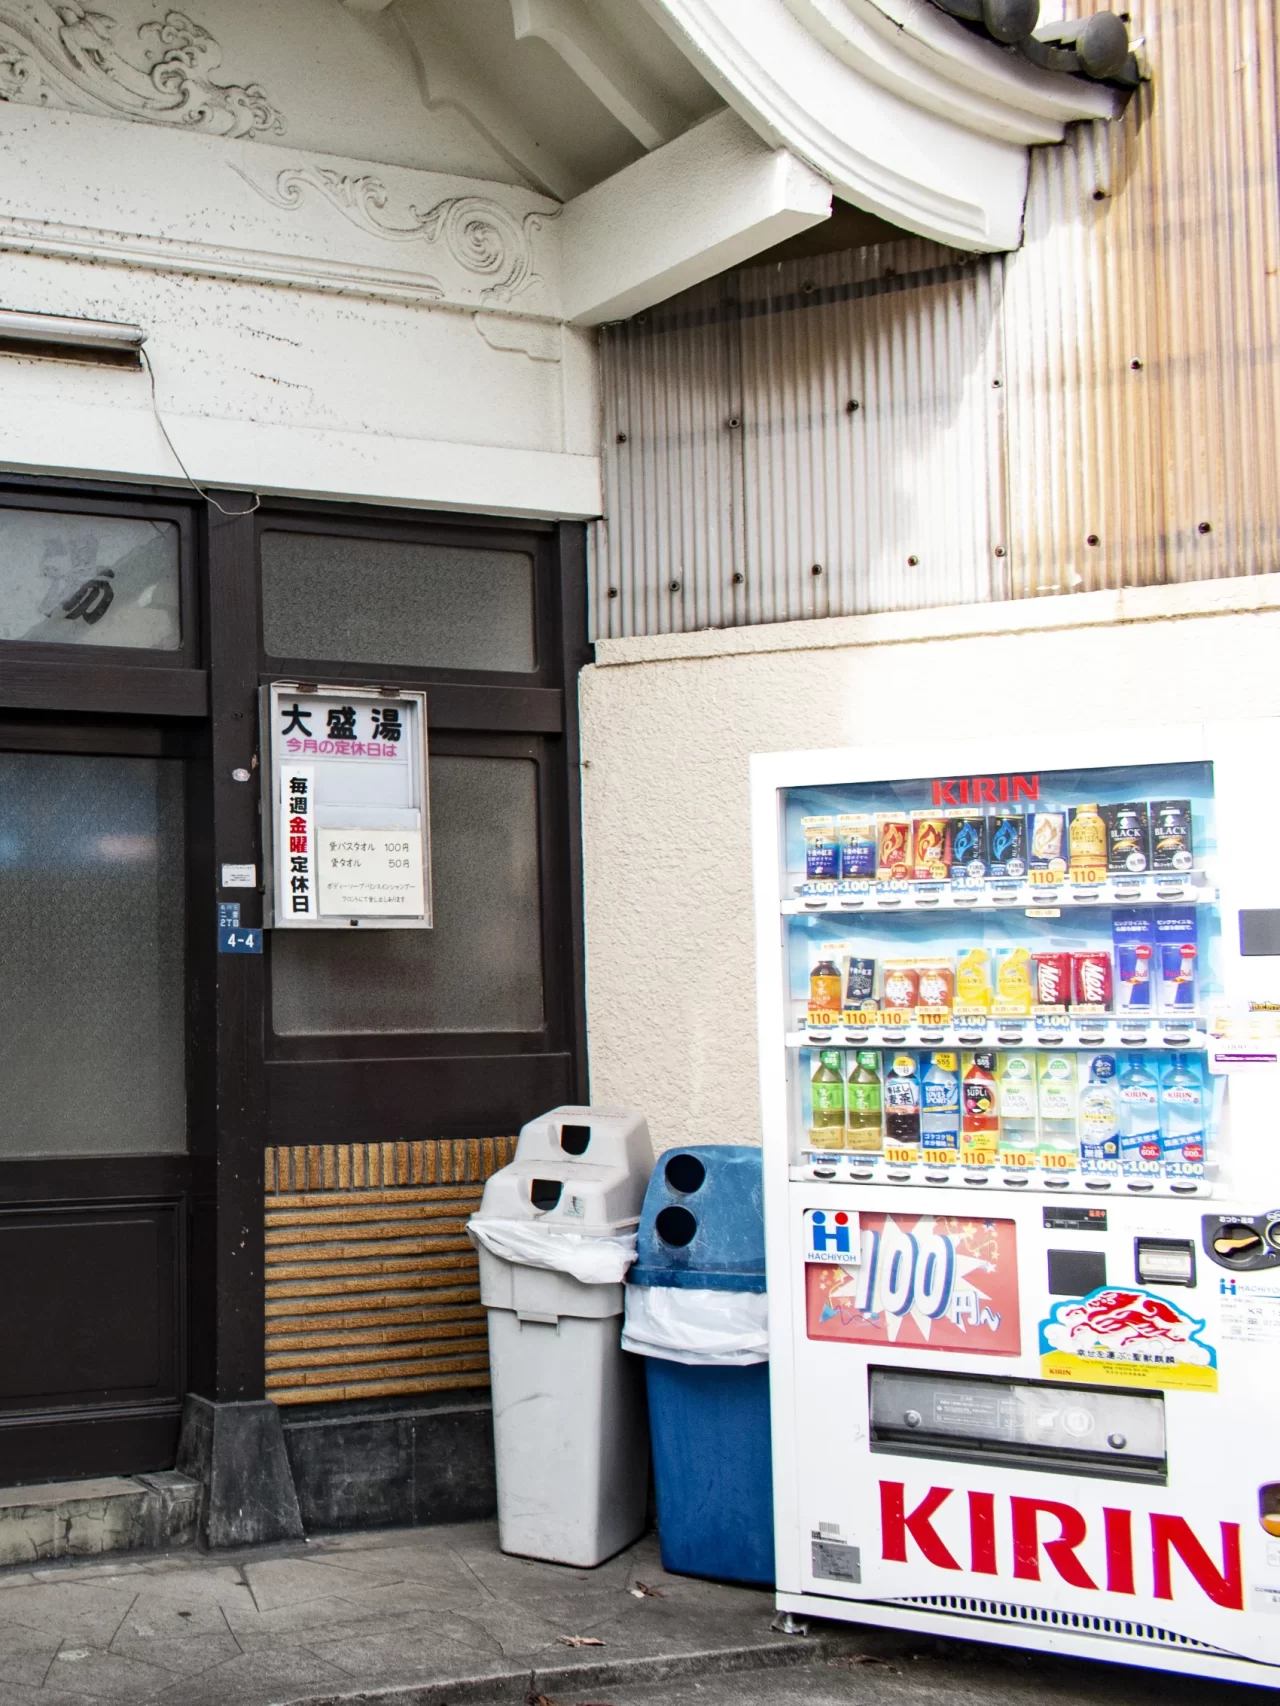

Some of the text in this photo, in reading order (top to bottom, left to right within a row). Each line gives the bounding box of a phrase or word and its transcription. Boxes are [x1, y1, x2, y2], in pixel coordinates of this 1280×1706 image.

[281, 703, 402, 742] 大盛湯
[286, 738, 398, 758] 今月の定休日は
[931, 775, 1040, 806] KIRIN
[1111, 828, 1141, 838] BLACK
[1154, 827, 1187, 836] BLACK
[289, 776, 310, 913] 毎週金曜定休日
[384, 843, 409, 852] 100円
[388, 859, 410, 868] 50円
[228, 933, 255, 948] 4-4
[1040, 963, 1059, 1002] Mets
[1086, 963, 1105, 1001] Mets
[808, 1252, 857, 1262] HACHIYOH
[1049, 1368, 1072, 1376] KIRIN
[878, 1479, 1245, 1611] KIRIN
